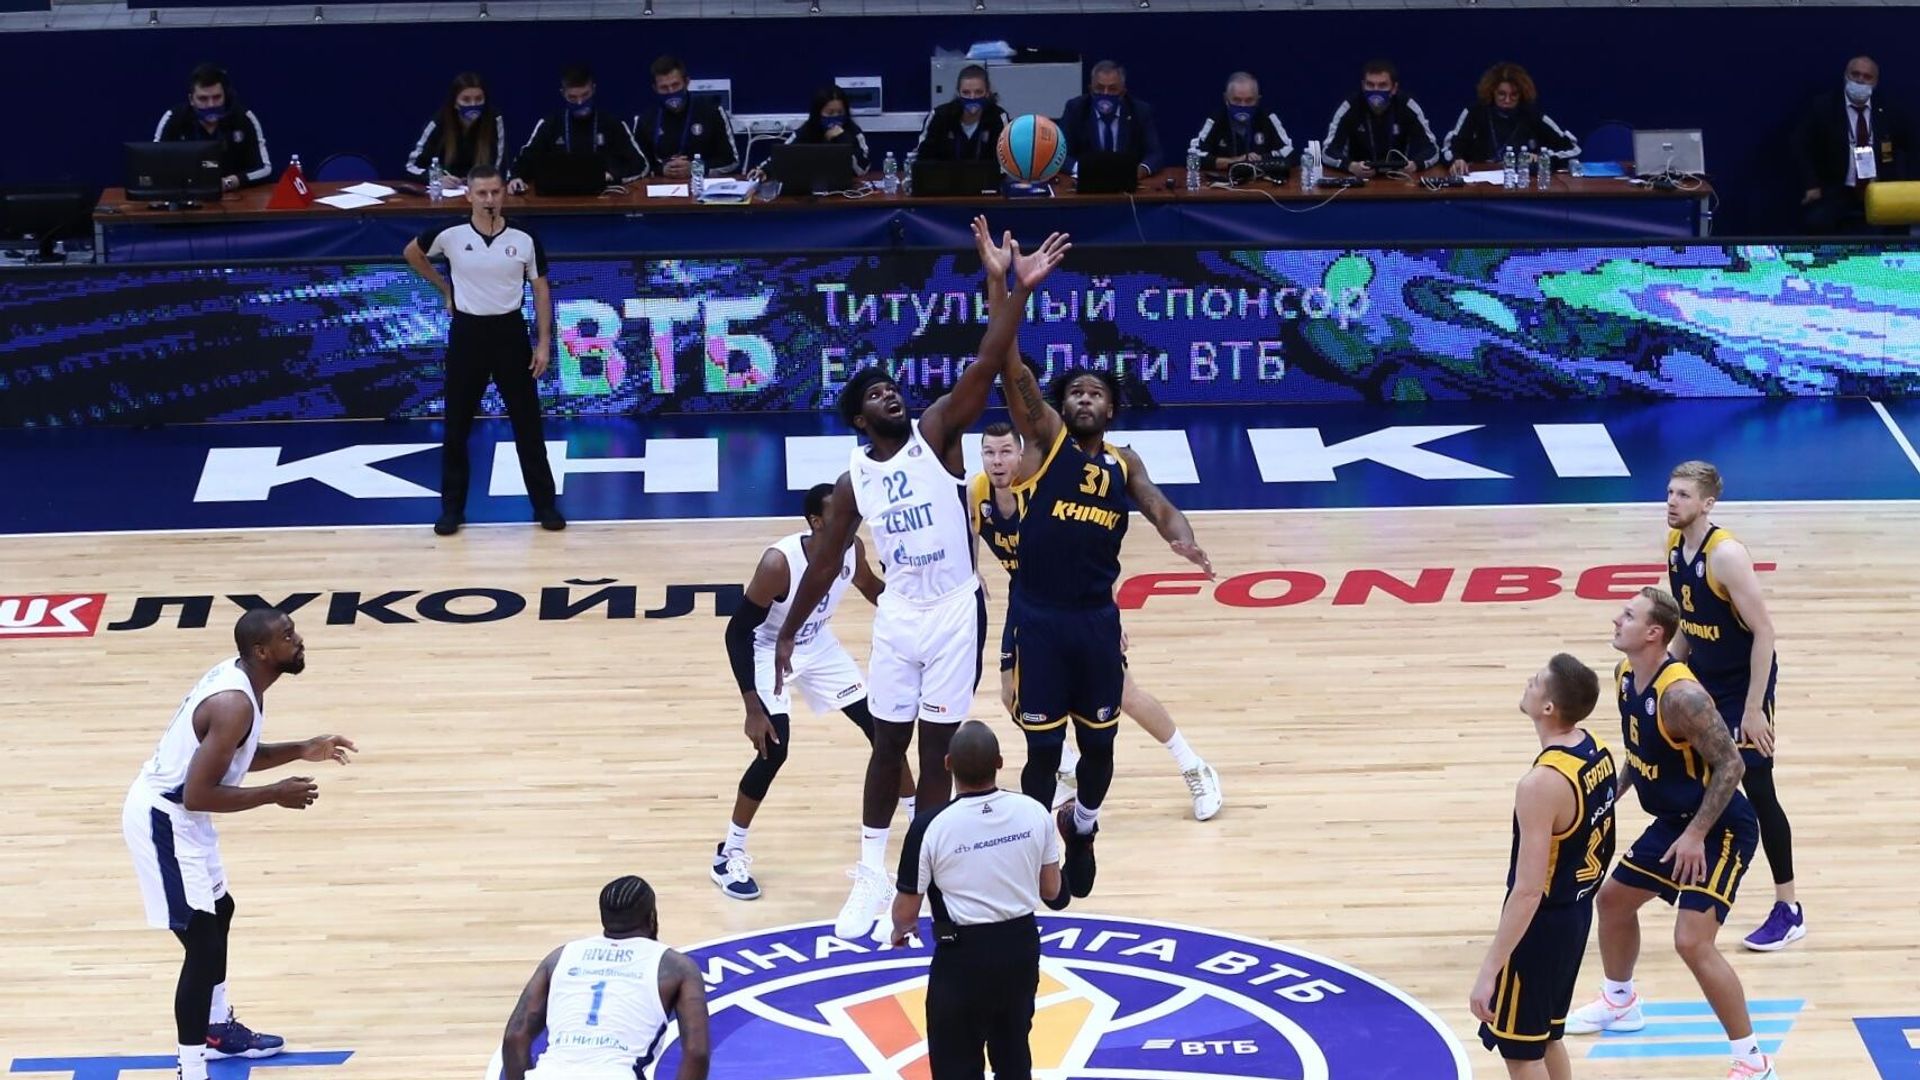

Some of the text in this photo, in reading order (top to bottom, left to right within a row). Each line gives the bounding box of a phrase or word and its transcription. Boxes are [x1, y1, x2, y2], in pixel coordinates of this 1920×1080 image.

[815, 278, 1370, 337] Титульый спонсор
[556, 290, 777, 394] ВТБ
[1191, 341, 1285, 383] ВТБ
[881, 470, 914, 504] 22
[1079, 462, 1111, 498] 31
[881, 502, 934, 535] ZENIT
[1051, 500, 1121, 531] KHIMKI
[1116, 562, 1777, 610] FONBE
[1681, 584, 1696, 612] 8
[107, 578, 748, 631] ЛУКОЙЛ
[1630, 715, 1640, 746] 6
[582, 947, 634, 963] RIVERS
[1037, 926, 1178, 963] ИГА
[1195, 950, 1347, 1003] ВТБ
[586, 981, 607, 1026] 1
[1181, 1039, 1259, 1056] ВТБ
